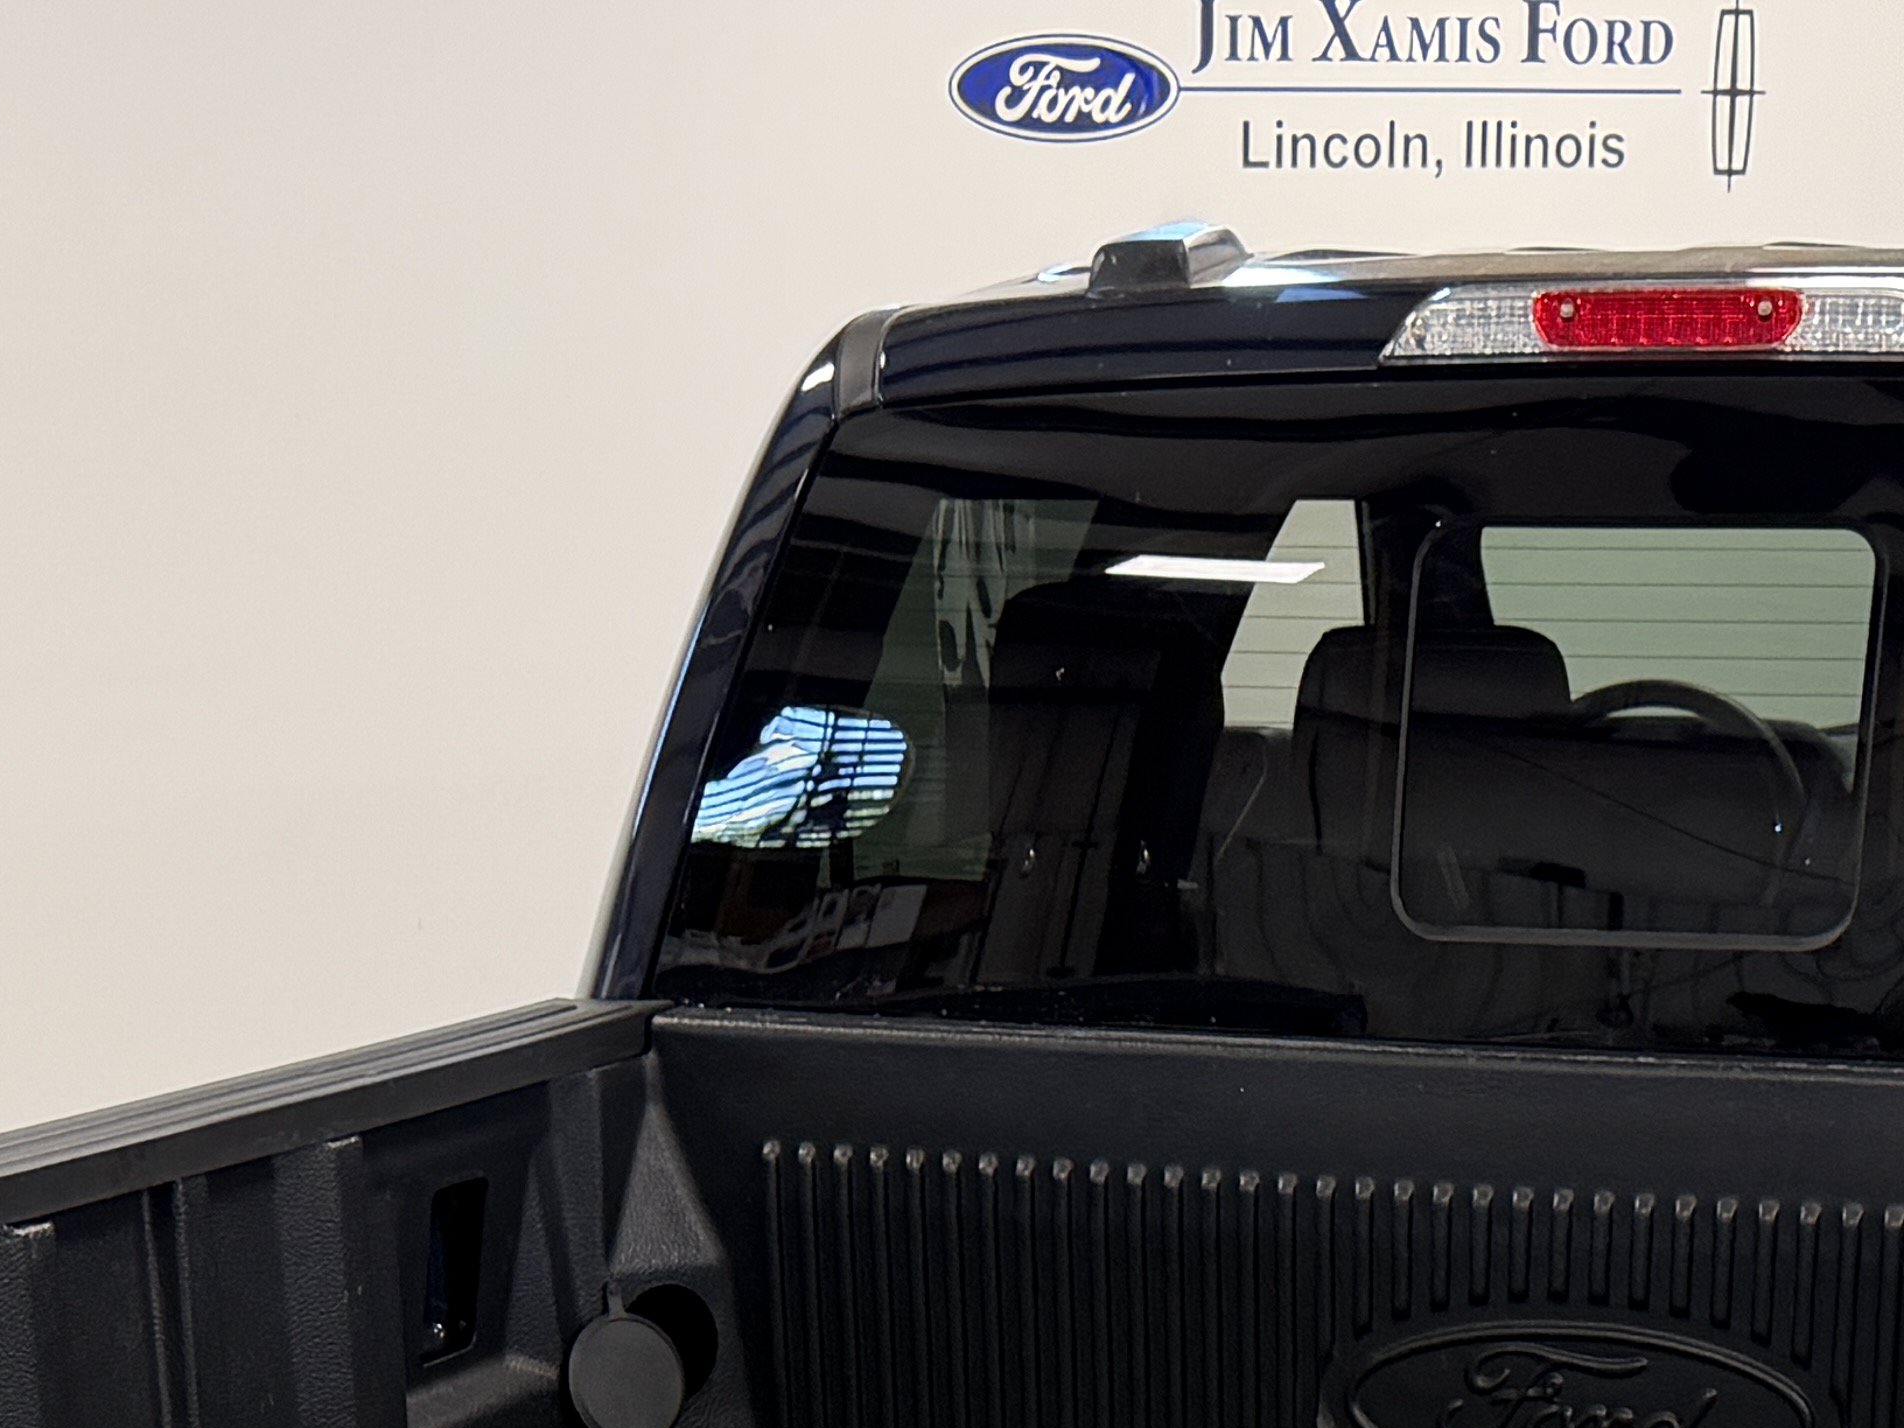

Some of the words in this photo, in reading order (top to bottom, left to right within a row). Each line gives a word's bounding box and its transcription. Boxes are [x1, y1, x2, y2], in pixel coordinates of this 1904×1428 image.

[1192, 0, 1291, 73] JIM
[1312, 0, 1499, 63] XAMIS
[1521, 0, 1673, 64] FORD
[995, 53, 1136, 123] Ford
[1242, 119, 1443, 178] Lincoln,
[1466, 120, 1625, 168] Illinois
